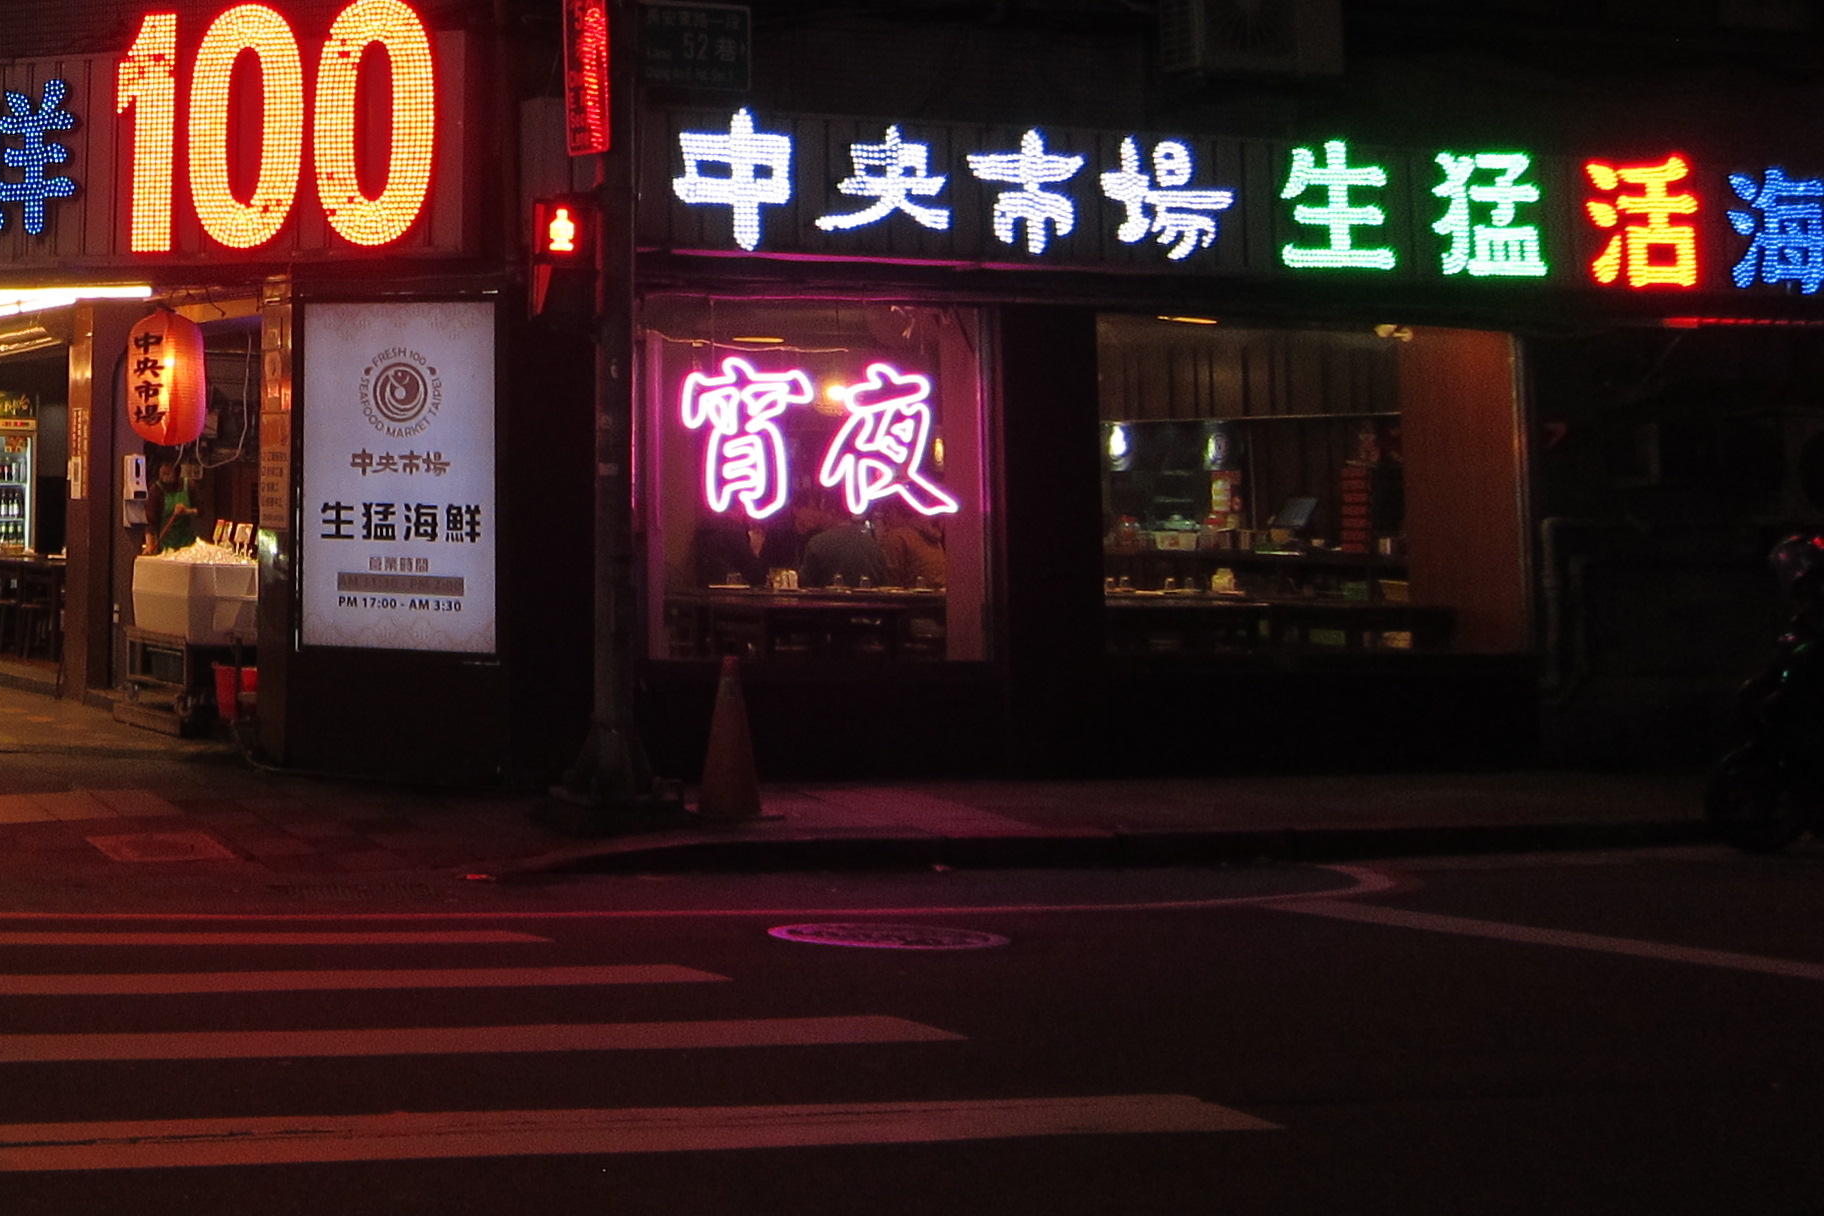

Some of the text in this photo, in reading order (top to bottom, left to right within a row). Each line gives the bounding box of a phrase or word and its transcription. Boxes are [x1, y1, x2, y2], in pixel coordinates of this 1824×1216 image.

[672, 107, 1234, 259] 中央市場
[133, 331, 167, 426] 中央市場
[371, 347, 407, 368] FRESH
[359, 377, 442, 438] SEAFOOD MARKET TAIPEI
[350, 448, 451, 477] 中央市場
[320, 501, 482, 544] 生猛海鮮
[338, 596, 358, 608] PM
[362, 597, 397, 610] 17:00
[409, 598, 430, 611] AM
[434, 600, 462, 613] 3:30
